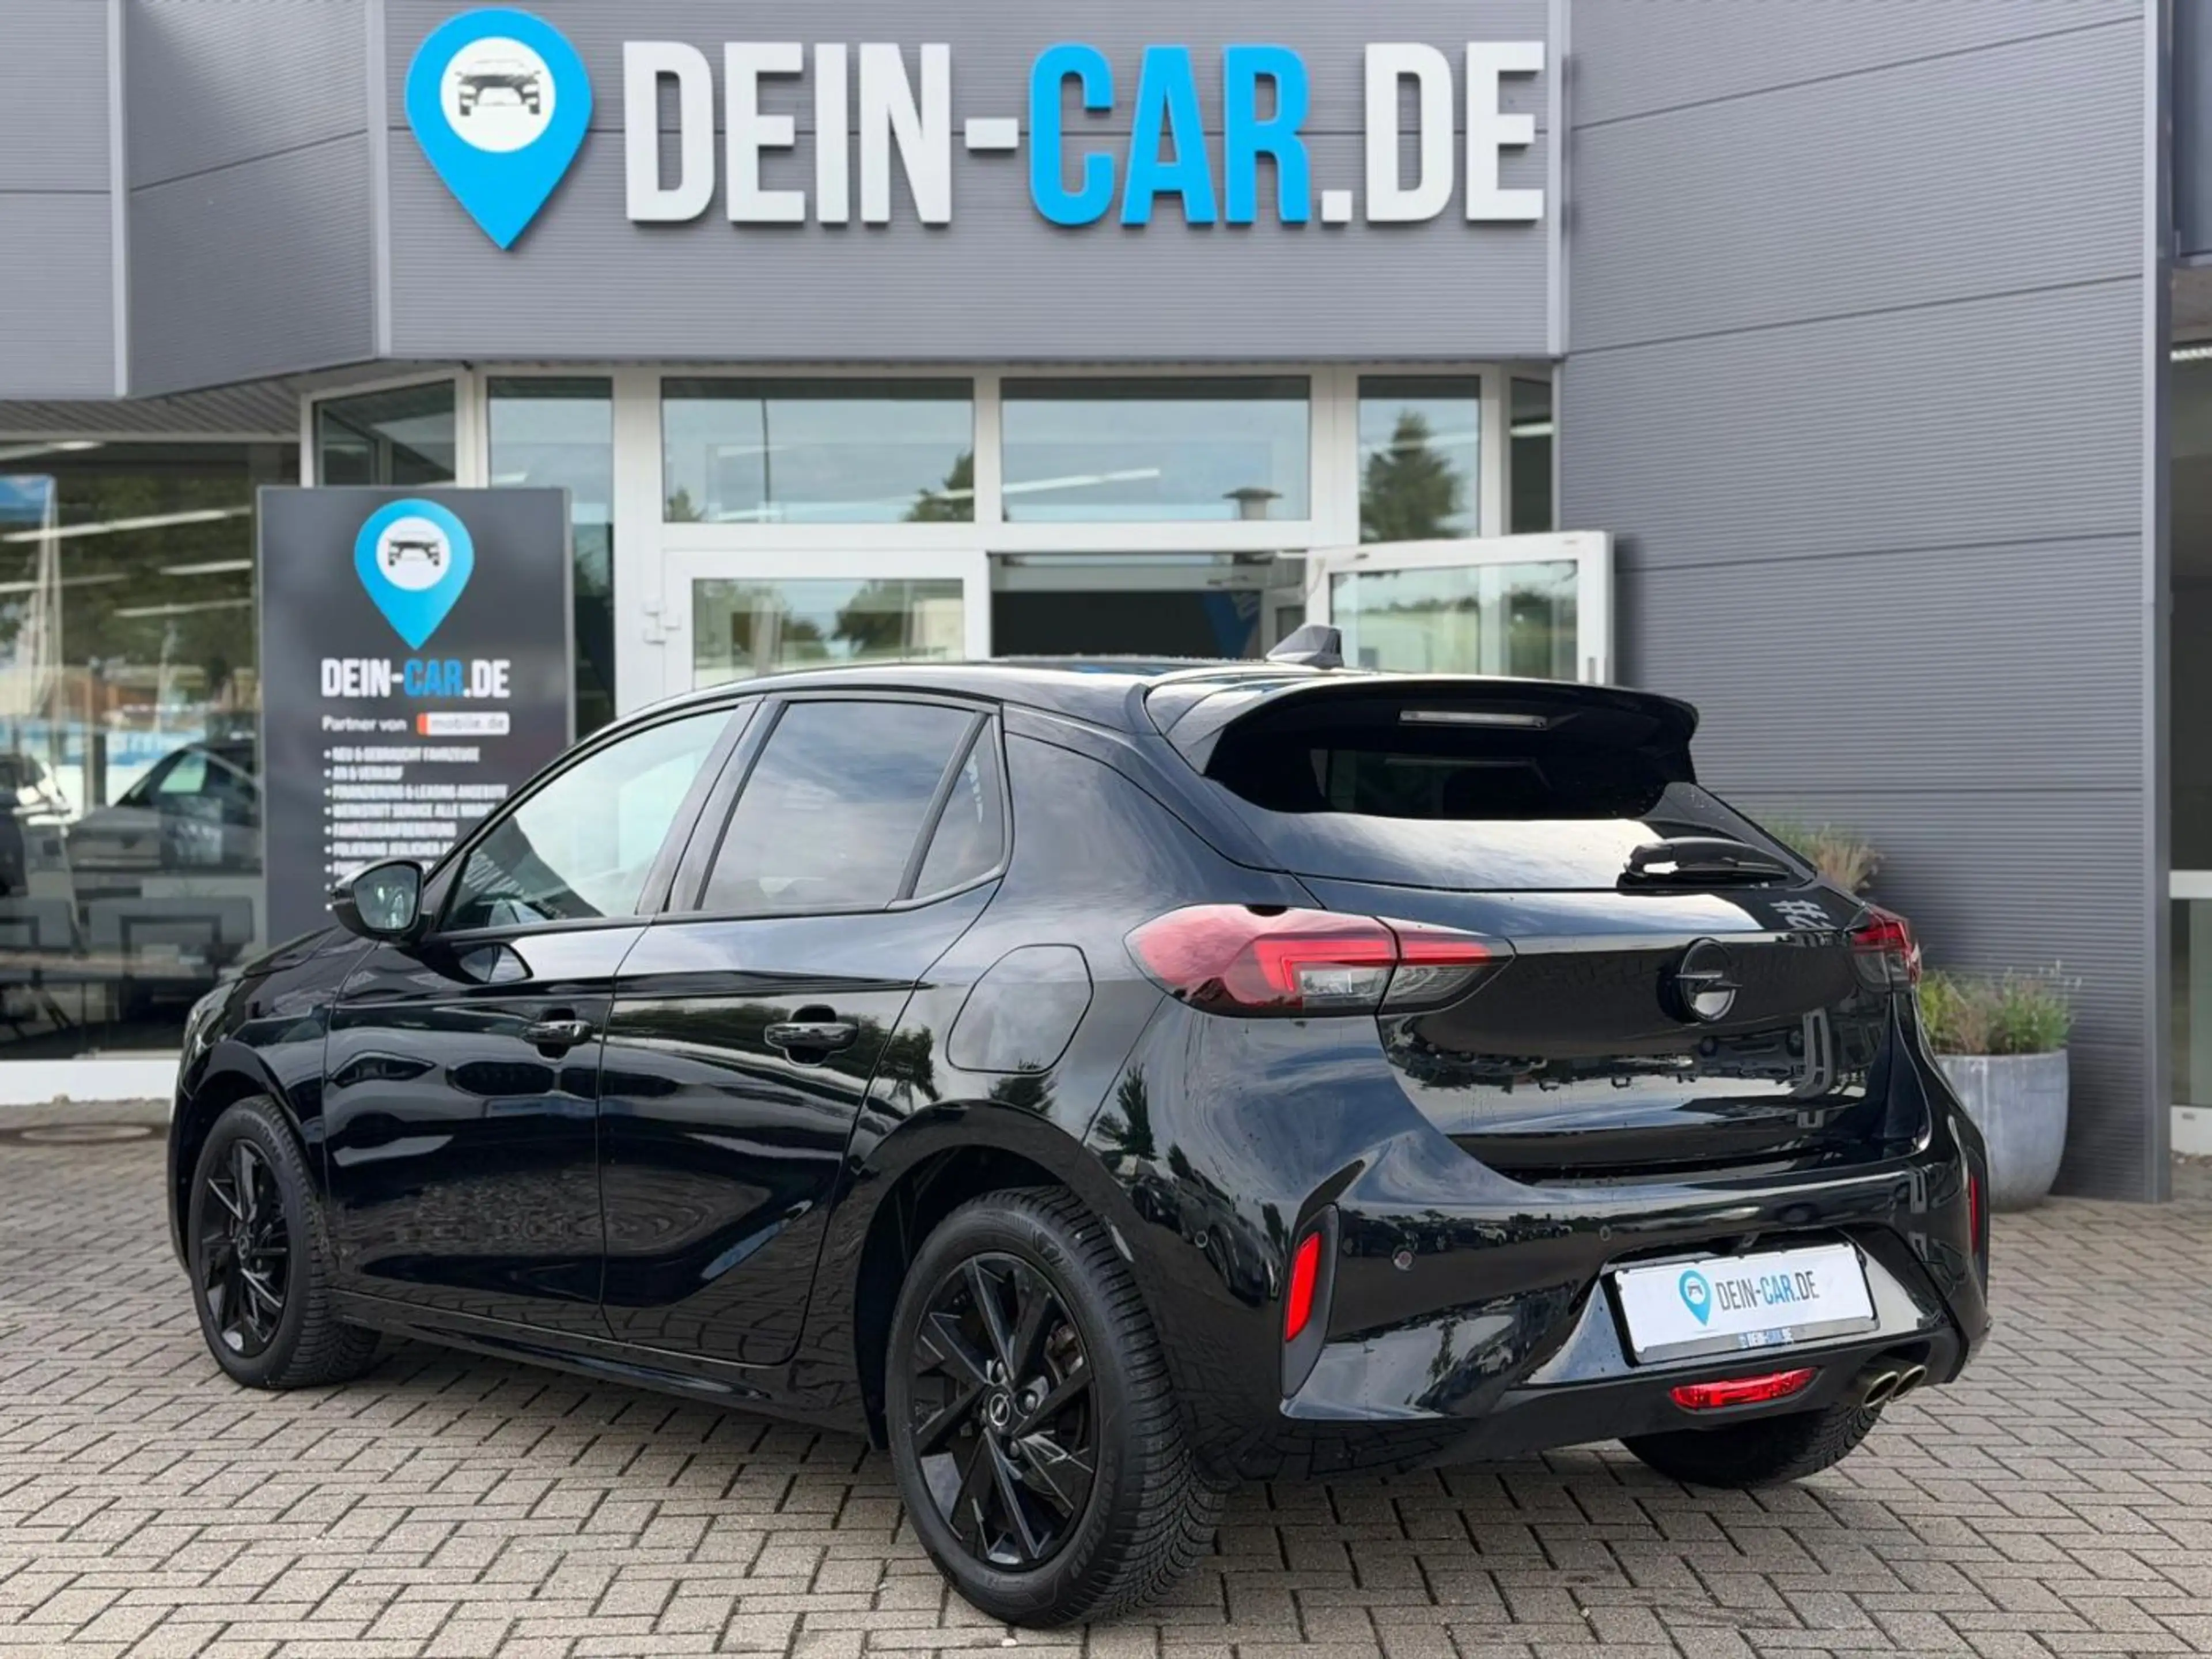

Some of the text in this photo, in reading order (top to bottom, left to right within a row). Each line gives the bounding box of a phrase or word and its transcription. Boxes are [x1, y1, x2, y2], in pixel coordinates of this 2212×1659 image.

[623, 41, 1545, 226] DEIN-CAR.DE
[320, 658, 510, 698] DEIN-CAR.DE
[322, 715, 376, 732] Partner
[379, 719, 408, 732] von
[1716, 1271, 1819, 1311] DEIN-CAR.DE
